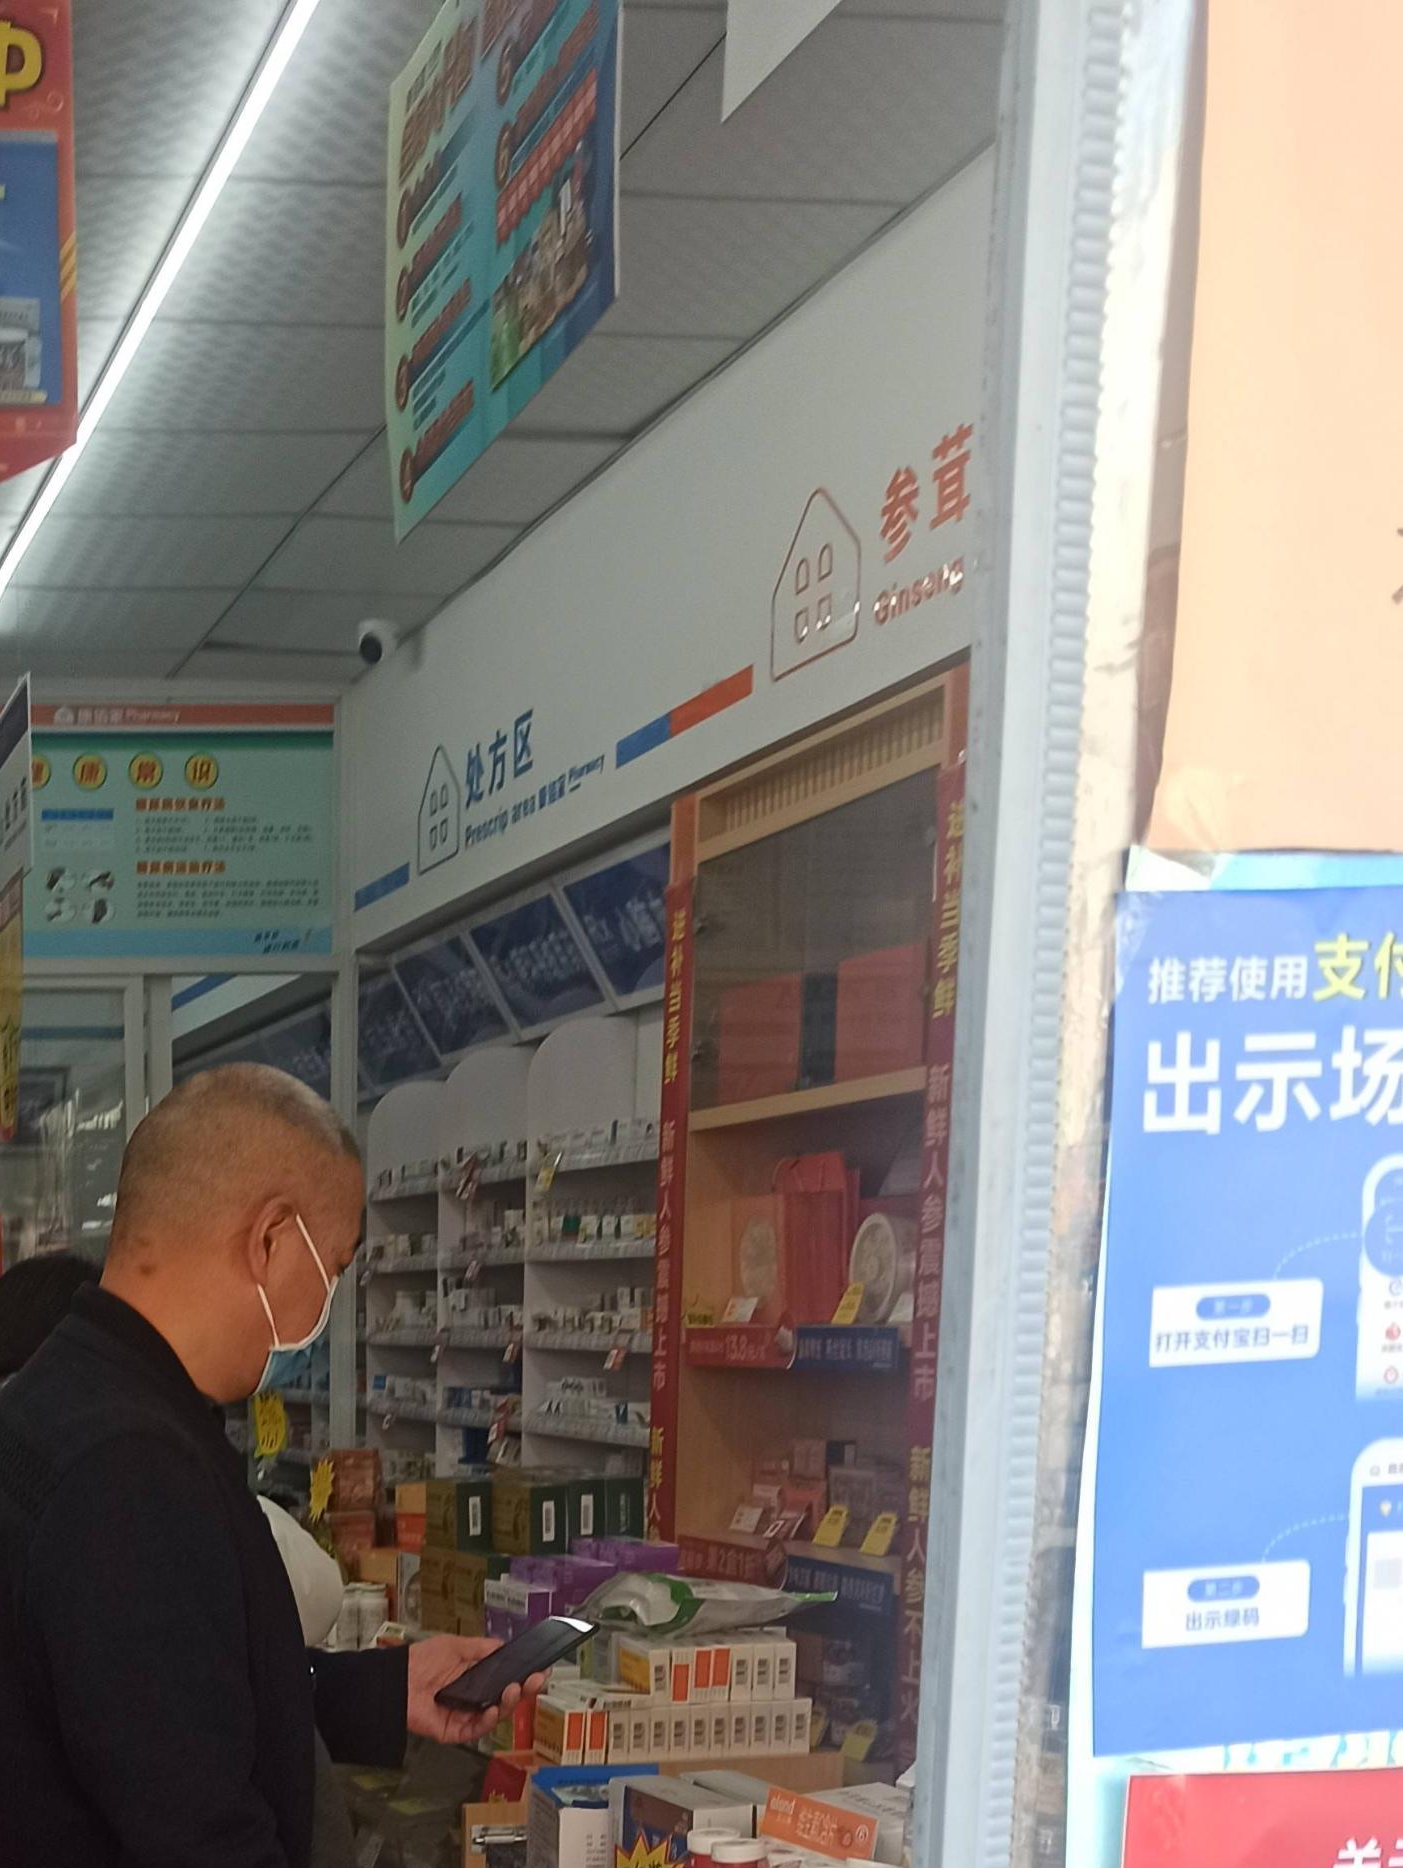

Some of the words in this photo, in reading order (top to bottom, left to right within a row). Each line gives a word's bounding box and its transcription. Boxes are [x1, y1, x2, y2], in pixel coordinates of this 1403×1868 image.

[878, 423, 974, 563] 参茸
[873, 556, 966, 625] Ginseng
[465, 708, 534, 810] 处方区
[1155, 1322, 1309, 1353] 打开支付宝扫一扫
[1185, 1610, 1260, 1632] 出示绿码
